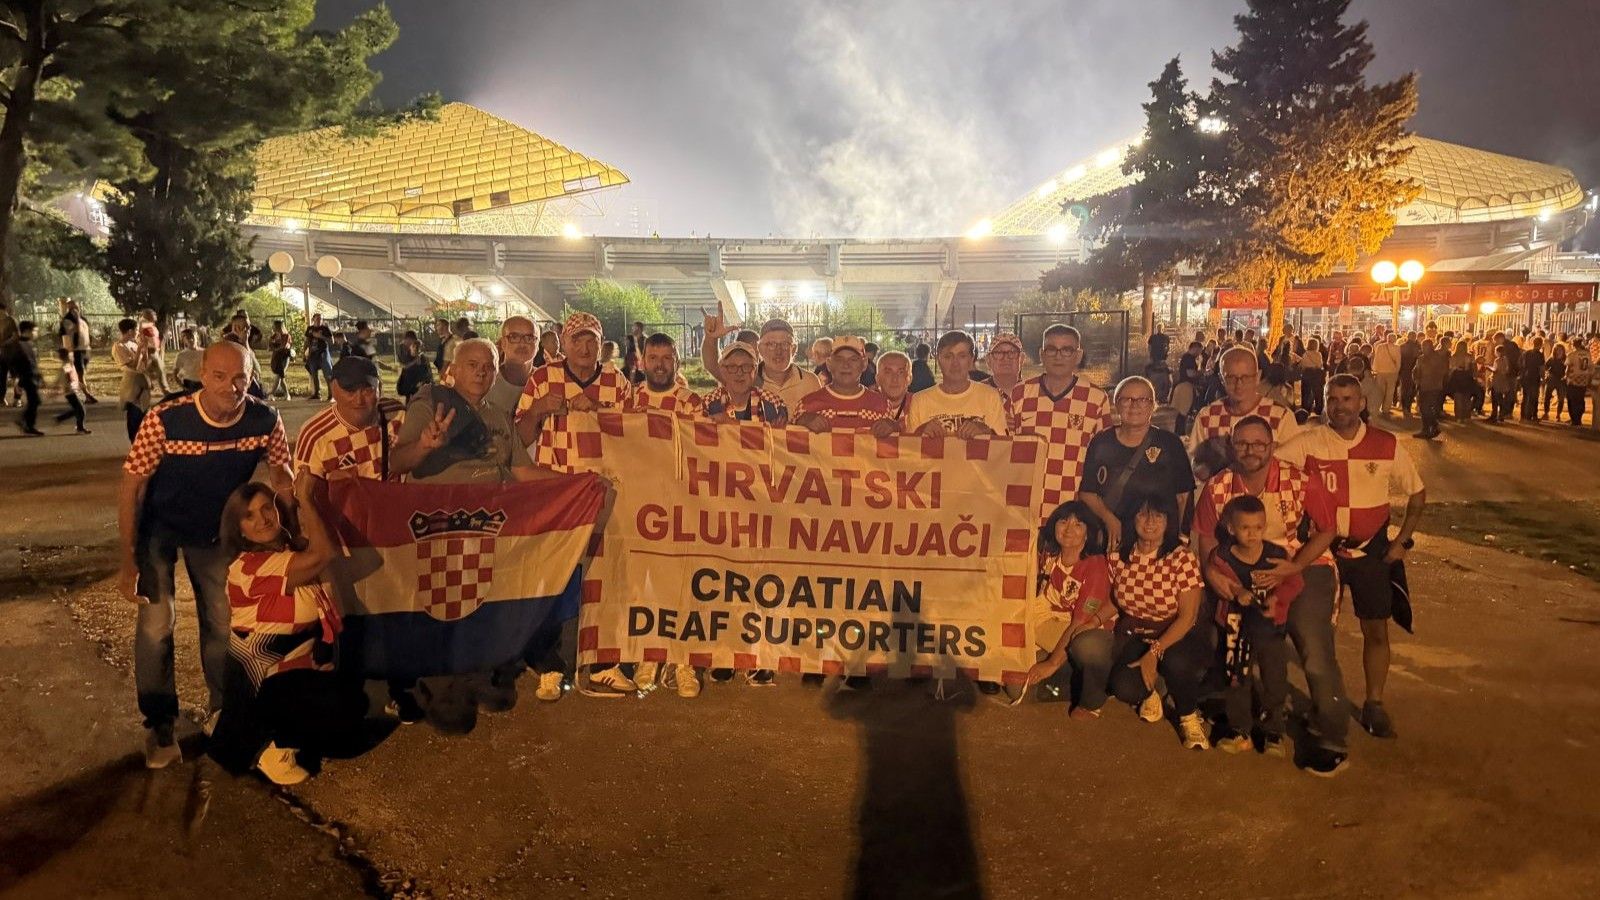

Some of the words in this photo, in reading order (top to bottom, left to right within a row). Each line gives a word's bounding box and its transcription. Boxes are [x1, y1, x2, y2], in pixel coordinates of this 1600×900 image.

[1422, 291, 1449, 302] WEST
[1532, 289, 1539, 299] D
[1547, 289, 1554, 298] E
[1562, 289, 1569, 298] F
[1576, 289, 1584, 297] G
[686, 456, 942, 510] HRVATSKI
[1320, 470, 1338, 494] 10
[636, 503, 773, 549] GLUHI
[788, 514, 992, 559] NAVIJAČI
[691, 568, 922, 614] CROATIAN
[628, 606, 730, 642] DEAF
[740, 611, 986, 658] SUPPORTERS
